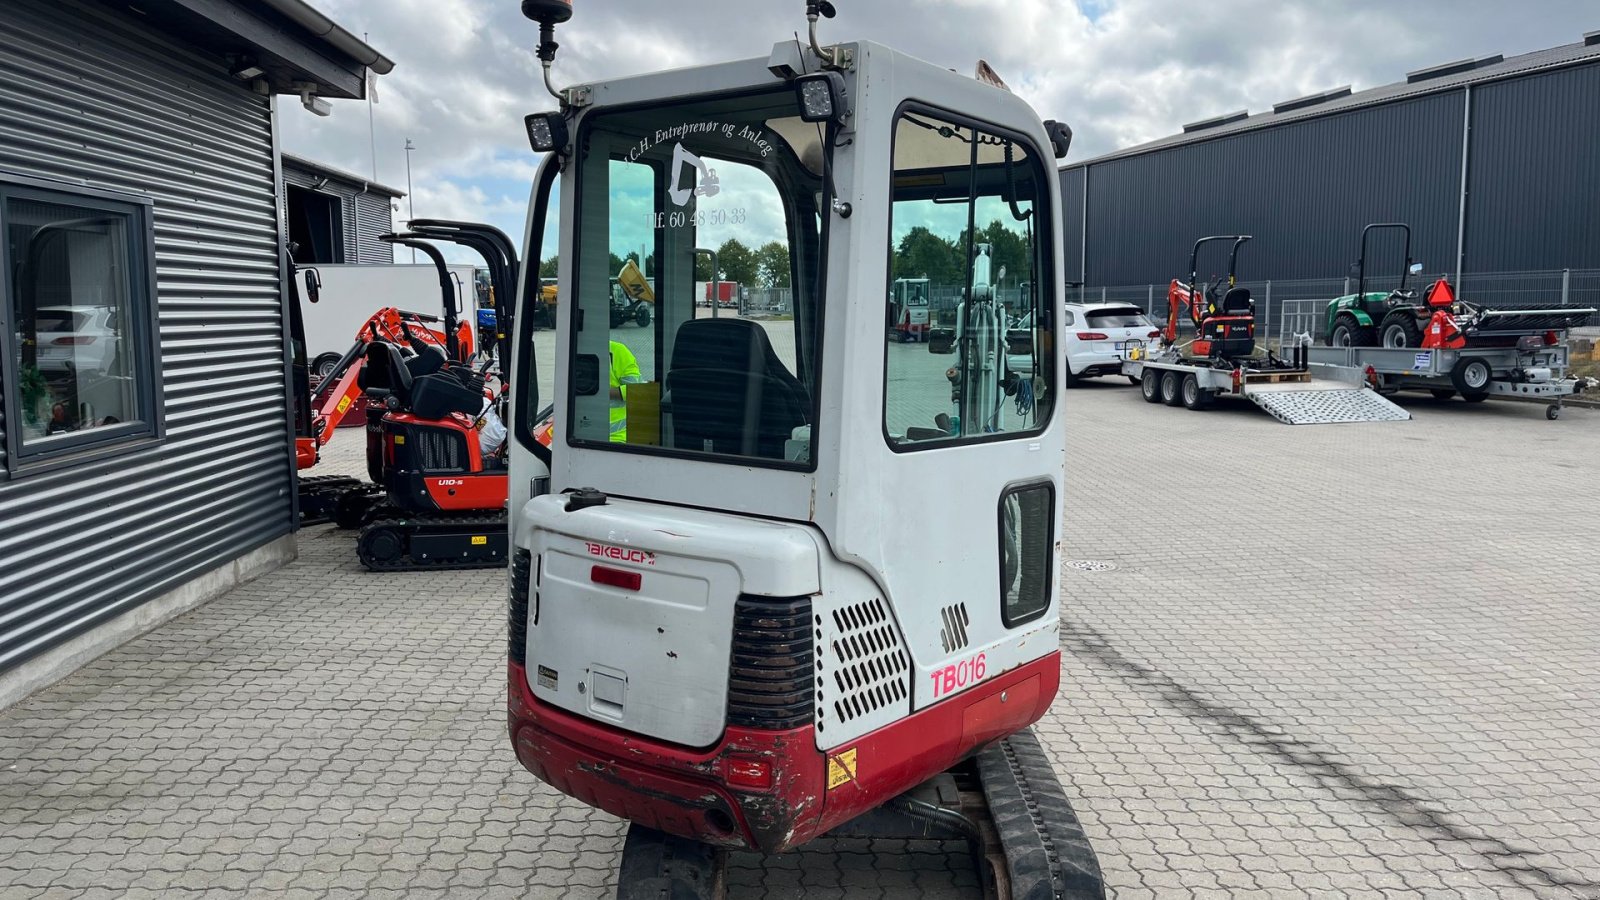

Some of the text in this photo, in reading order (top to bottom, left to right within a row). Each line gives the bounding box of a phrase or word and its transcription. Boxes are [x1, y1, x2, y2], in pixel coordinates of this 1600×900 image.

[655, 121, 719, 144] Entreprenør
[721, 123, 736, 138] og
[738, 125, 773, 157] Anlæg
[642, 207, 746, 228] Tlf. 60 48 50 33
[930, 652, 986, 698] TB016
